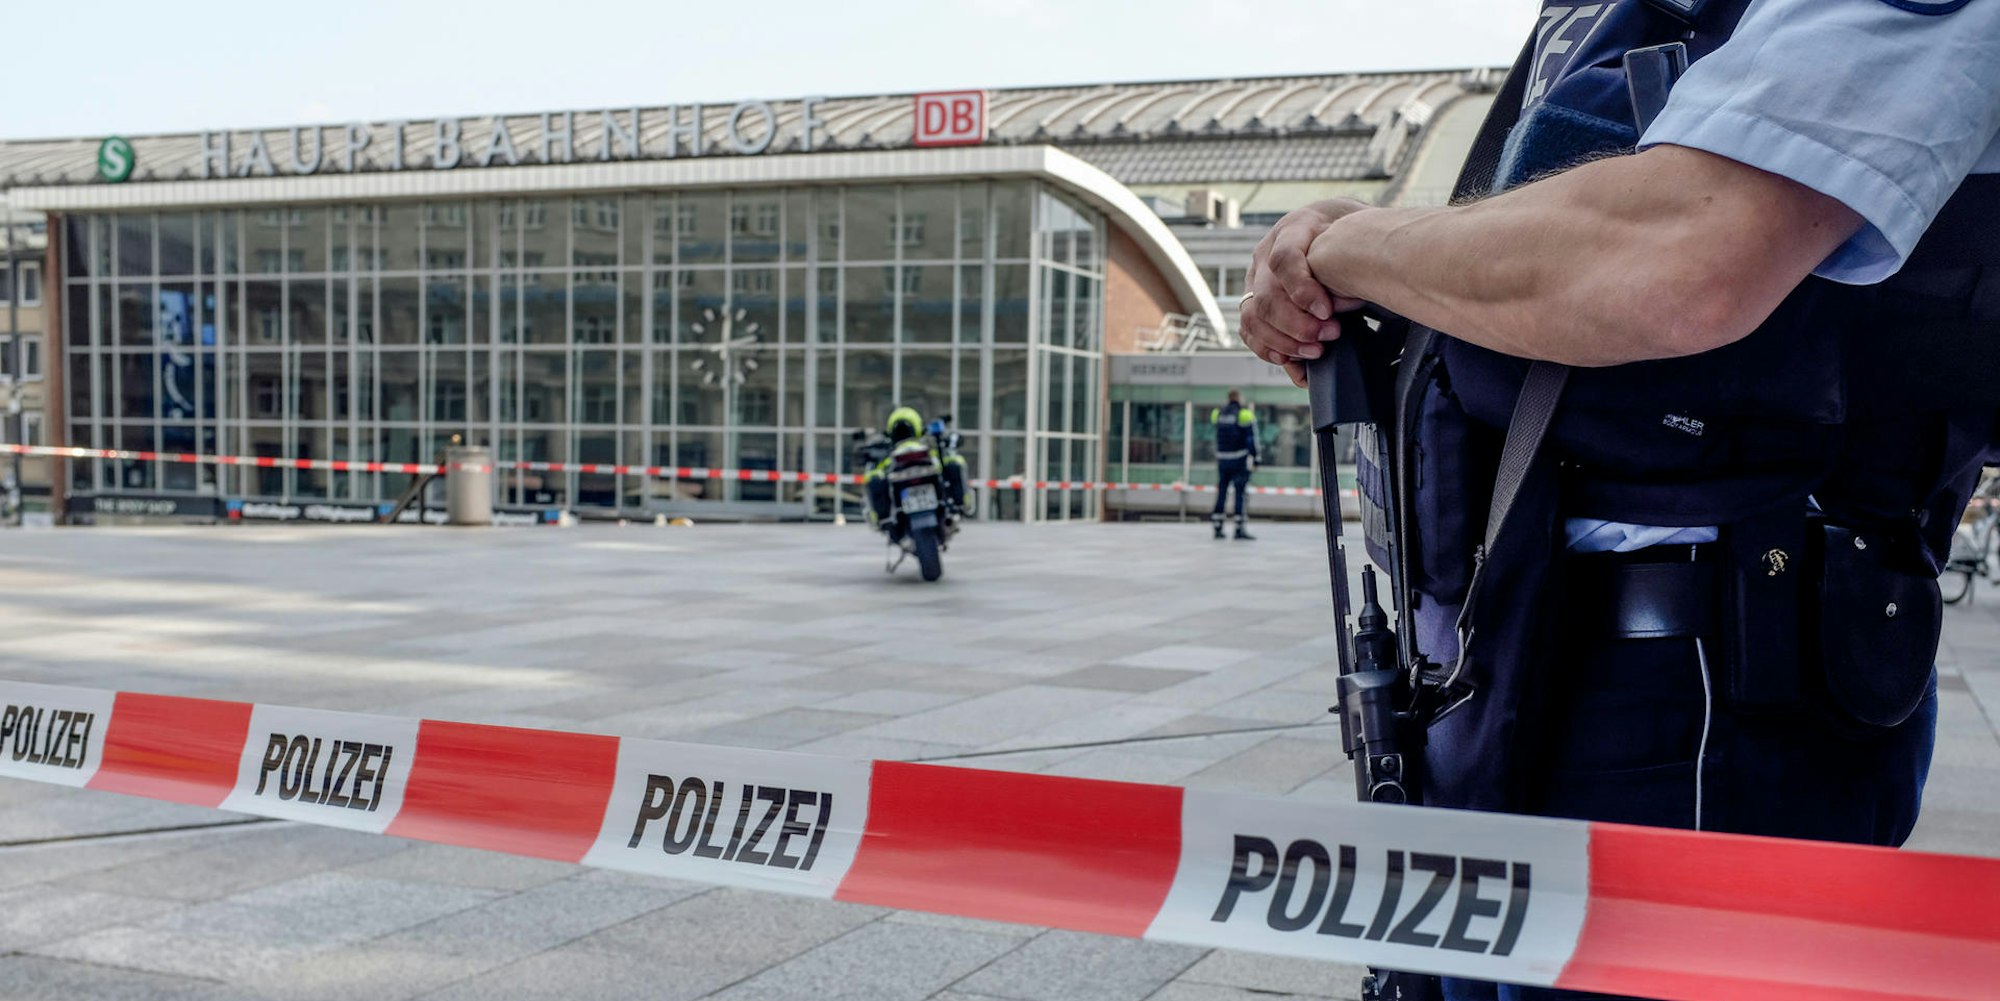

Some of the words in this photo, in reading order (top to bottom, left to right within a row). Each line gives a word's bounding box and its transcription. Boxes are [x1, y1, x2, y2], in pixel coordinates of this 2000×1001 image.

[200, 97, 828, 178] HAUPTBAHNHOF
[923, 100, 973, 135] DB
[102, 138, 129, 178] S
[0, 705, 95, 769] POLIZEI
[255, 733, 393, 812] POLIZEI
[627, 774, 833, 871] POLIZEI
[1210, 834, 1532, 957] POLIZEI
